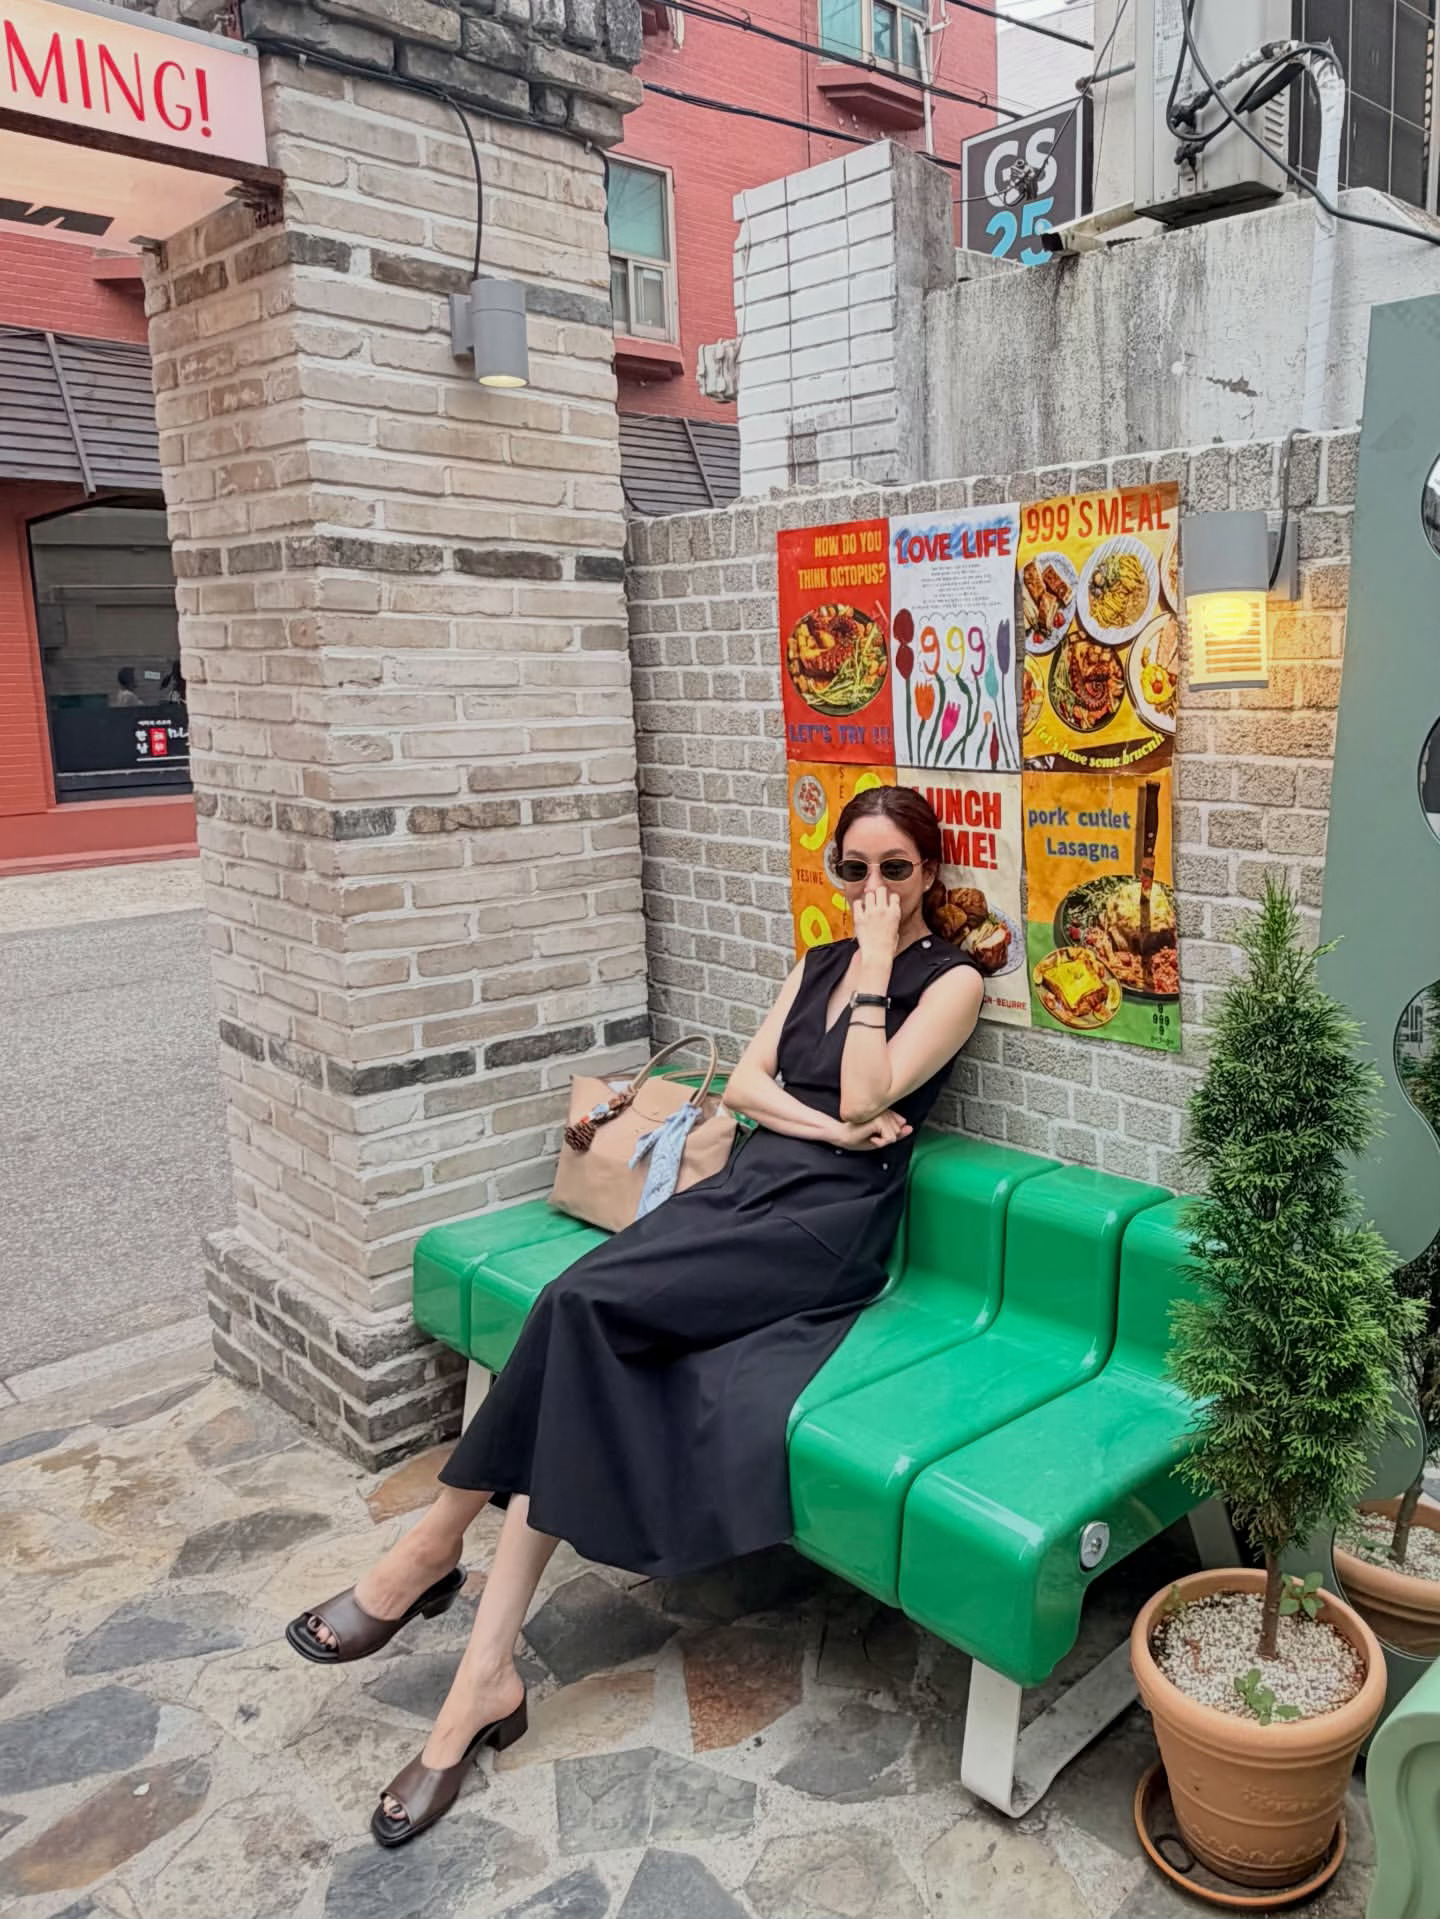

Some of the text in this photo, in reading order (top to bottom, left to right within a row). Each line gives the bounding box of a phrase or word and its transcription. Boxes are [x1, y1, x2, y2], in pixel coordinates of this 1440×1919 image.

[4, 19, 212, 138] MING!
[984, 128, 1057, 207] GS
[985, 196, 1054, 266] 25
[1026, 491, 1170, 544] 999'S MEAL
[814, 530, 882, 558] HOW DO YOU
[896, 527, 1011, 565] LOVE LIFE
[798, 562, 886, 590] THINK OCTOPUS?
[838, 724, 865, 745] TRY
[1059, 743, 1088, 766] have
[1089, 754, 1120, 768] some
[912, 786, 1001, 830] UNCH
[1028, 807, 1131, 830] pork cutlet
[942, 829, 998, 870] ME!
[1046, 837, 1120, 863] Lasagna
